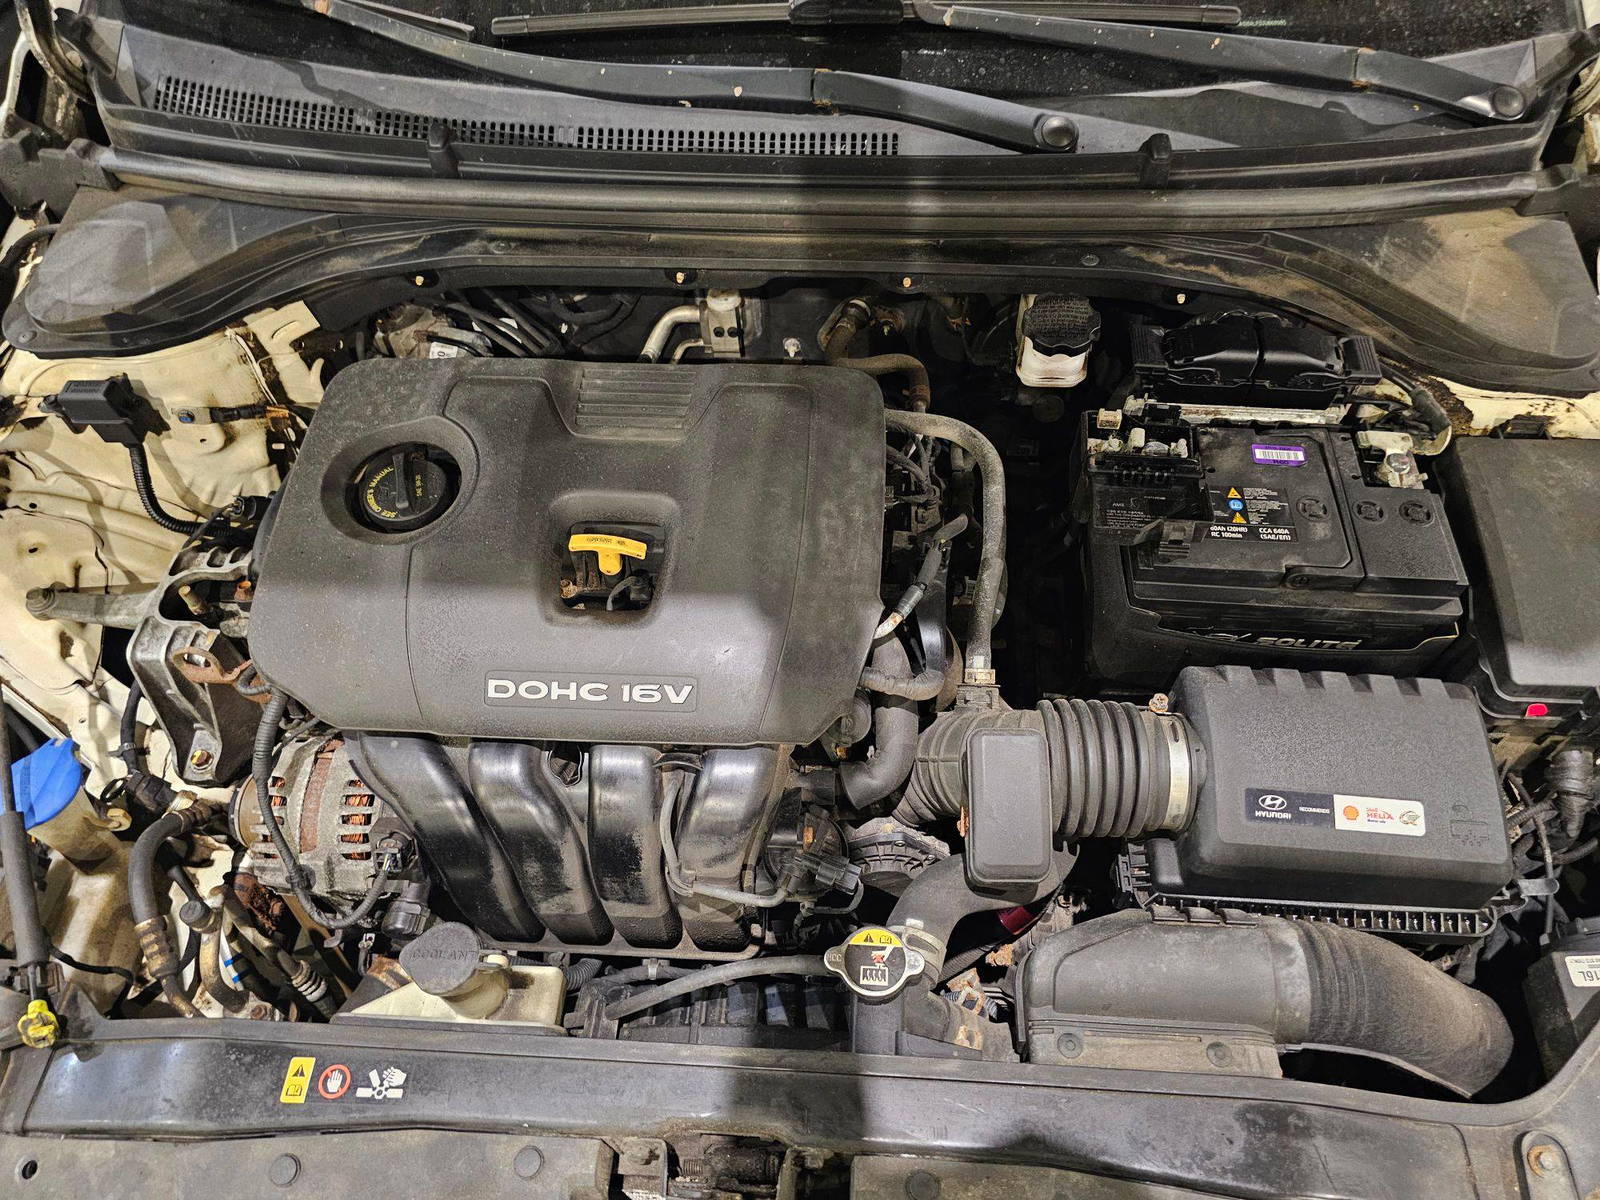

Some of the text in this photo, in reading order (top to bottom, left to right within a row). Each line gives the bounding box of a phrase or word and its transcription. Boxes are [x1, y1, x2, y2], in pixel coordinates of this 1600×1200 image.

[369, 467, 394, 487] MANUAL
[487, 679, 693, 704] DOHC 16V
[1255, 810, 1292, 820] HYUNDAI
[1366, 812, 1395, 820] HELIX
